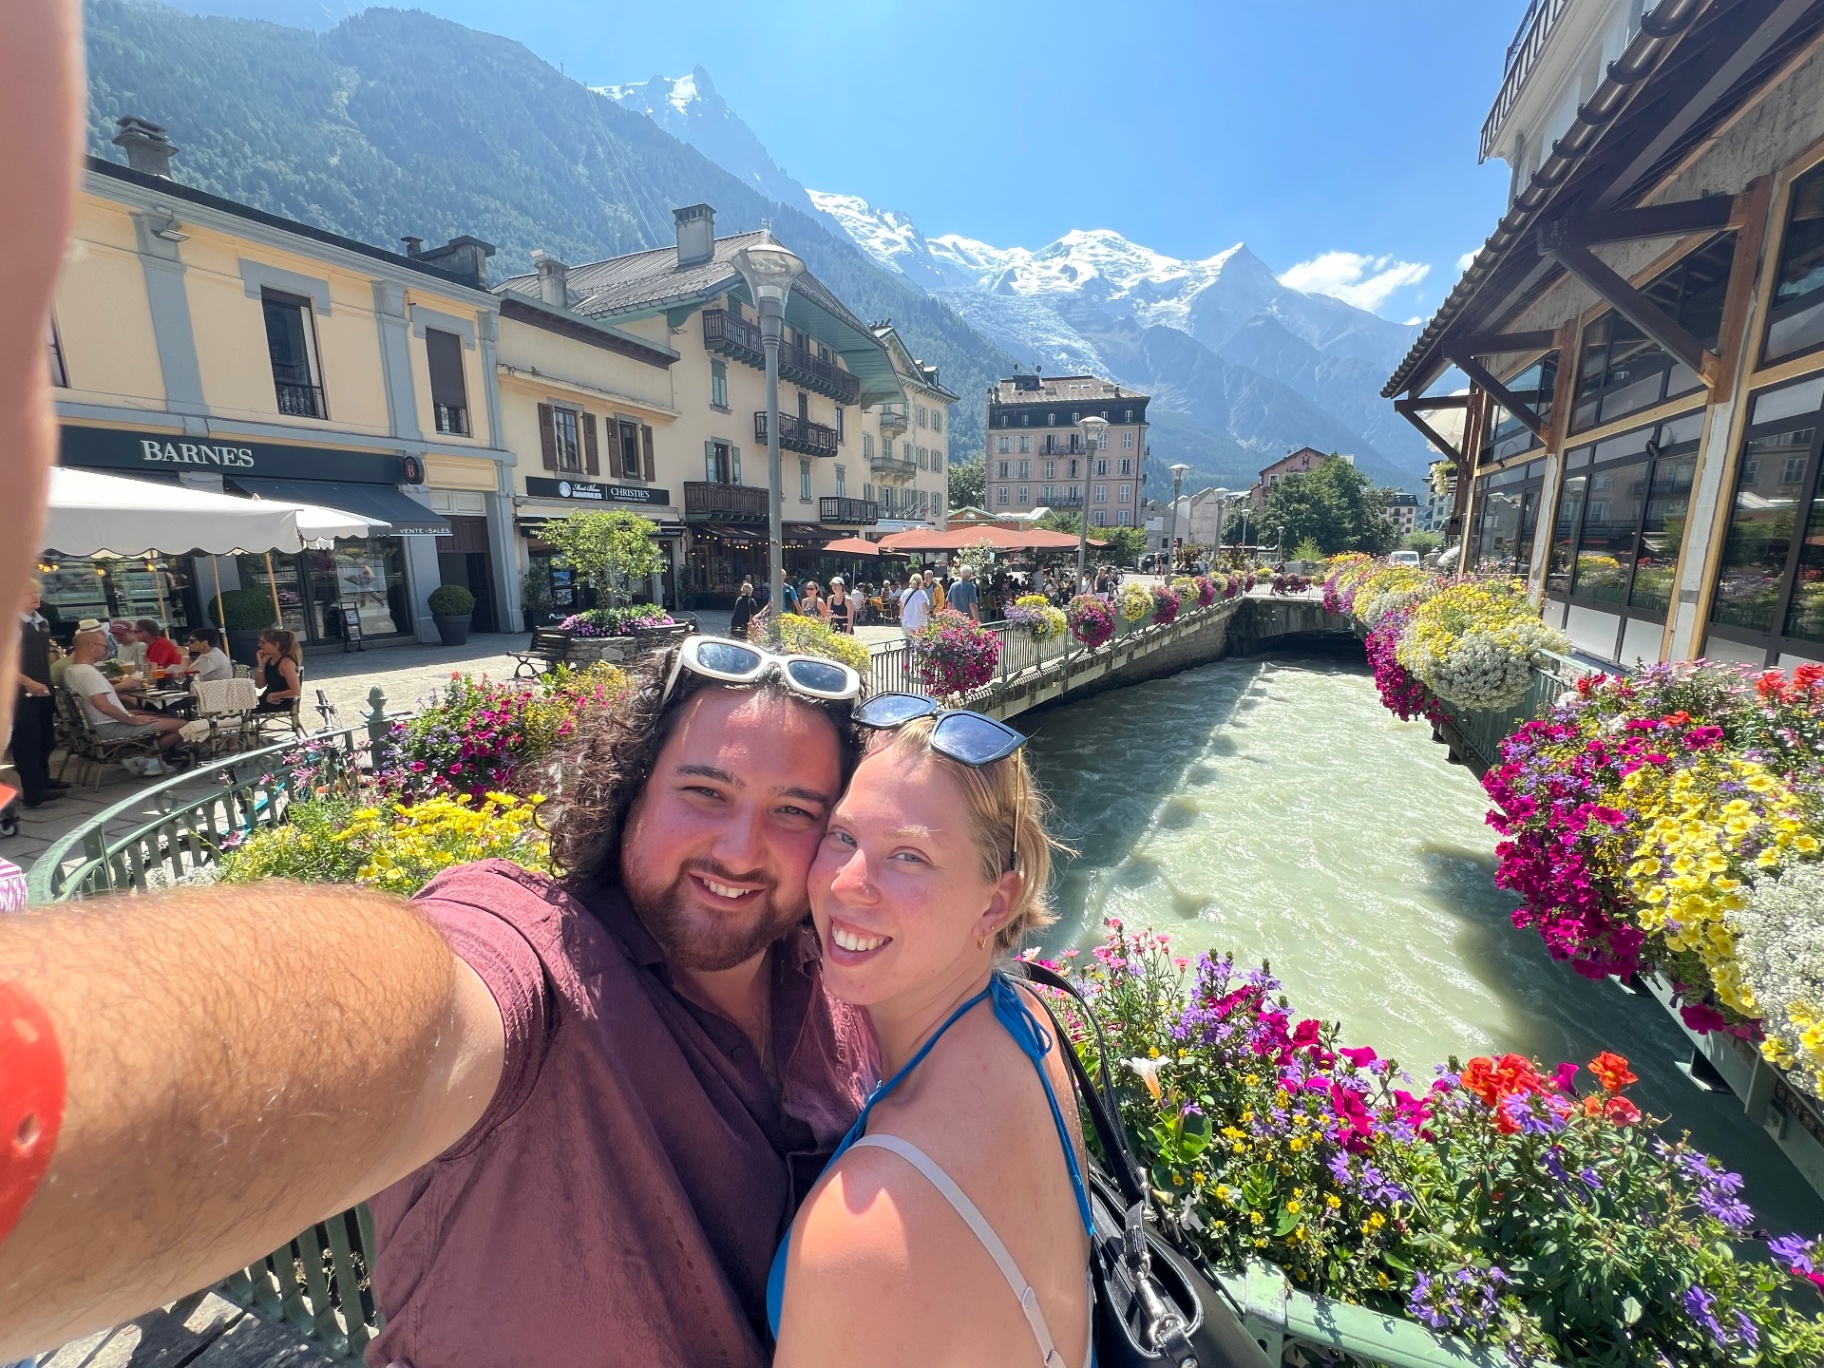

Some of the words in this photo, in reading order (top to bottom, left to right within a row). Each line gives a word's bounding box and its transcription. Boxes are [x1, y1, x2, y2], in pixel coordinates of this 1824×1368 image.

[140, 440, 255, 468] BARNES
[407, 465, 415, 478] B
[610, 487, 650, 499] CHRISTIE'S
